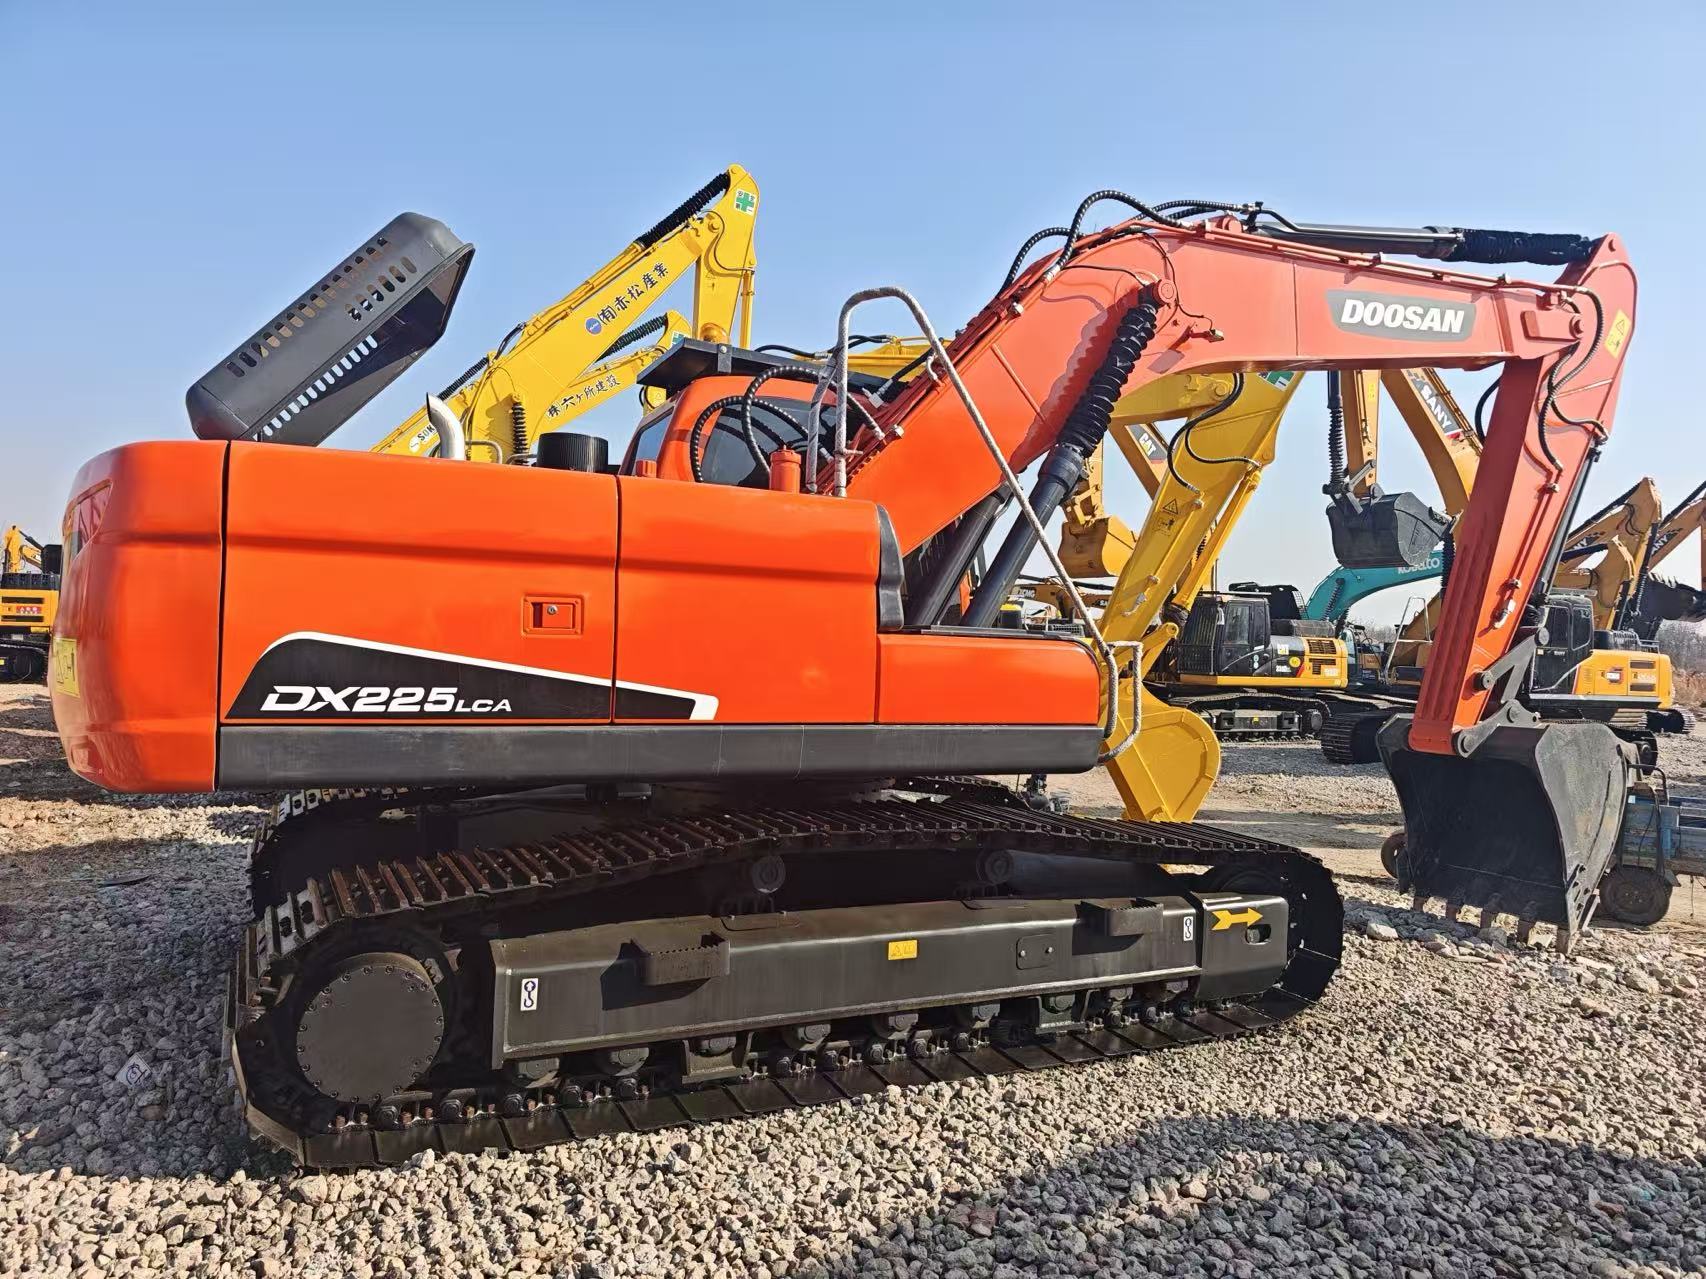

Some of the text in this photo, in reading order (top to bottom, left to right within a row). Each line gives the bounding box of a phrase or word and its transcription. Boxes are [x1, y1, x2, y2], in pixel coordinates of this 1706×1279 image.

[1340, 299, 1465, 333] DOOSAN
[1420, 384, 1452, 429] SANY
[1138, 432, 1157, 457] CAT
